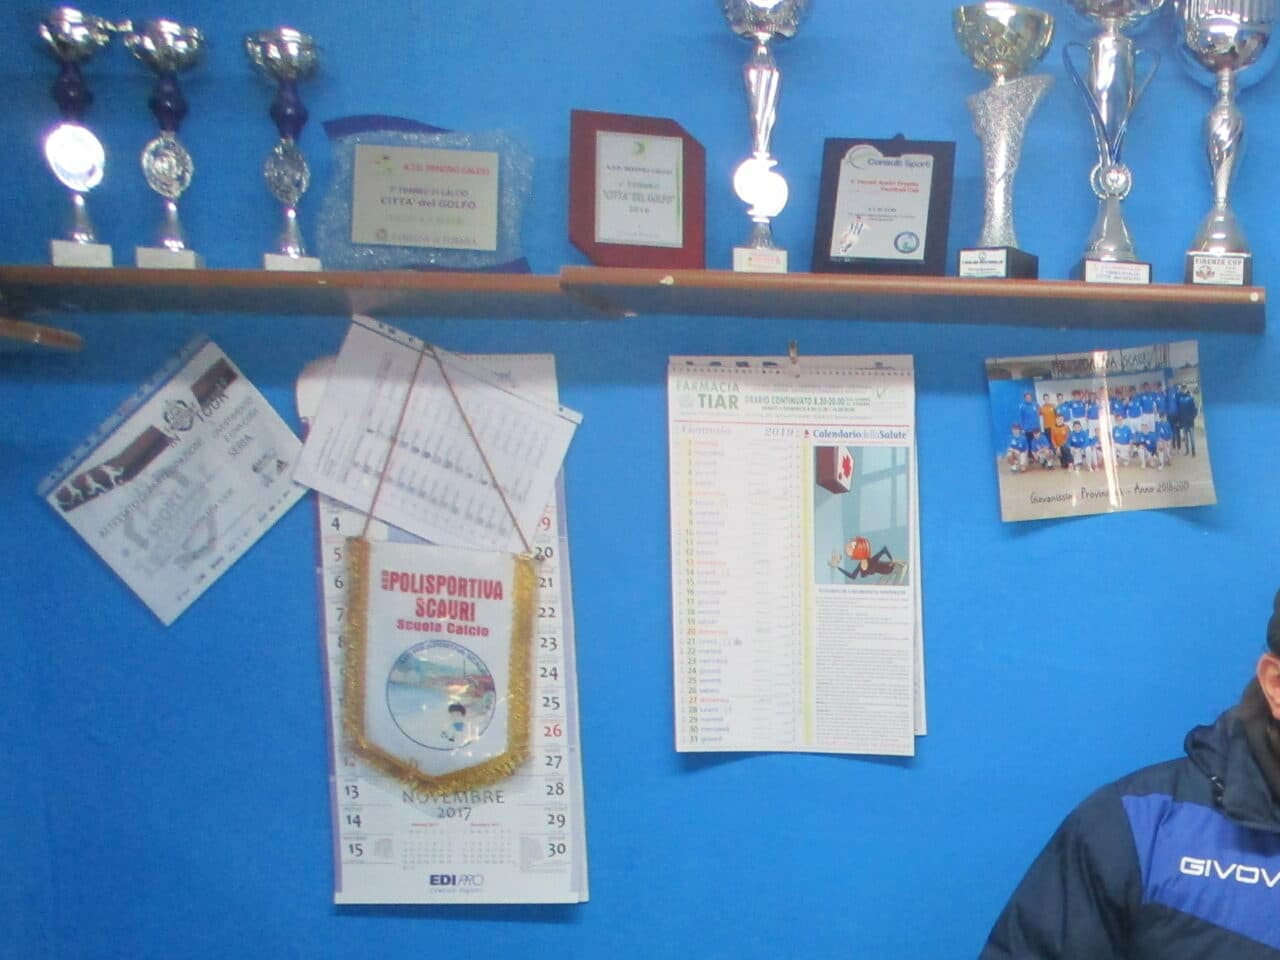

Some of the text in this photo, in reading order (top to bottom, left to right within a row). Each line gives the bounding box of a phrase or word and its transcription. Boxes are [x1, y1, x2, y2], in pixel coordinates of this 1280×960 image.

[697, 393, 739, 409] TIAR
[331, 517, 341, 530] 4
[333, 547, 342, 562] 5
[334, 575, 344, 589] 6
[389, 571, 504, 601] POLISPORTIVA
[538, 577, 553, 588] 21
[336, 607, 345, 622] 7
[415, 597, 476, 622] SCAURI
[538, 607, 556, 619] 22
[396, 618, 490, 637] Scuola Calcio
[540, 637, 557, 651] 23
[540, 667, 558, 681] 24
[542, 697, 560, 710] 25
[544, 725, 562, 738] 26
[545, 754, 563, 769] 27
[345, 784, 360, 799] 13
[546, 782, 565, 796] 28
[346, 814, 361, 828] 14
[437, 806, 472, 821] 2017
[547, 812, 566, 828] 29
[349, 843, 364, 858] 15
[549, 843, 567, 858] 30
